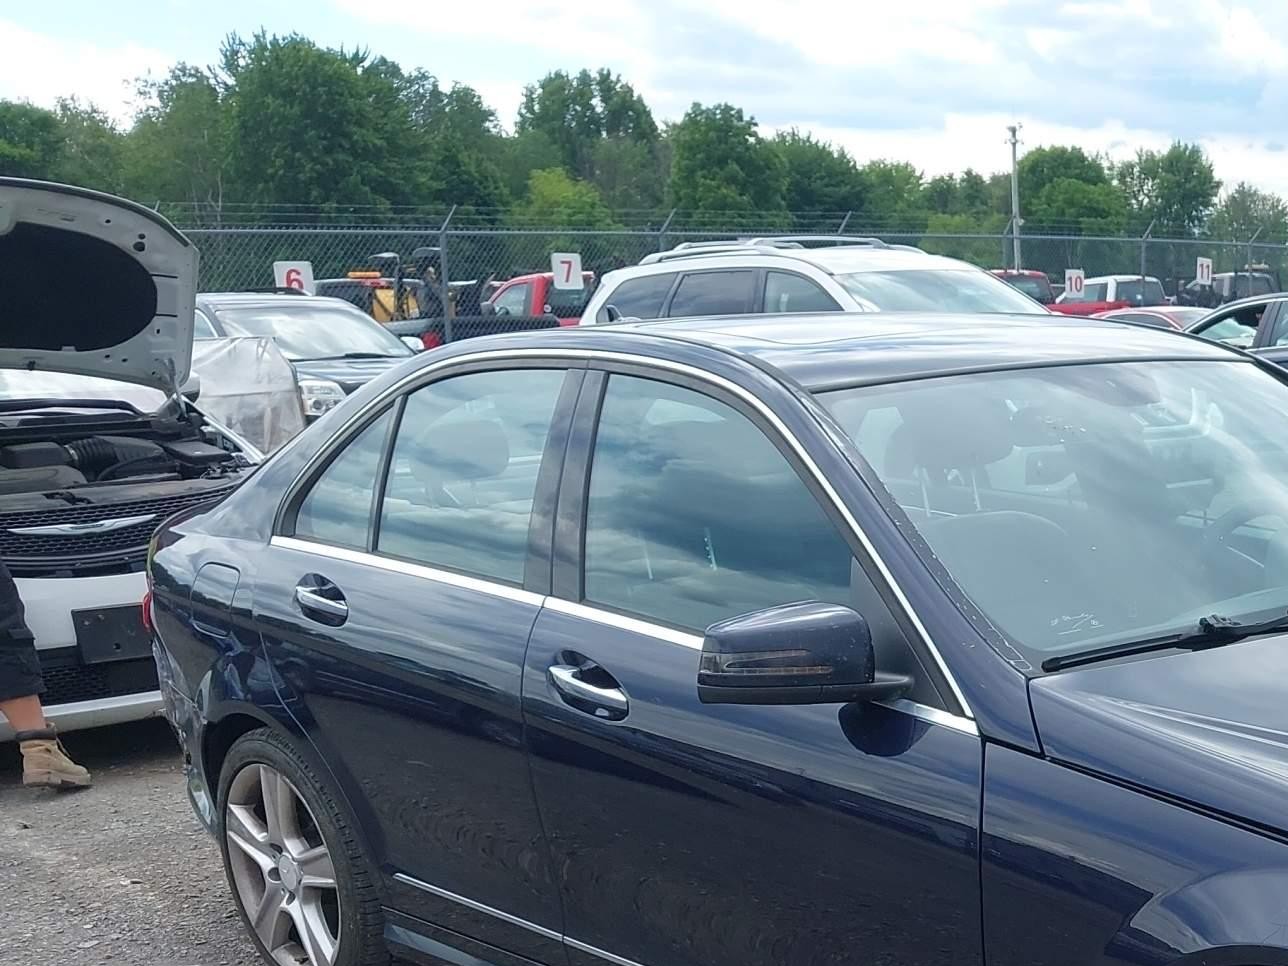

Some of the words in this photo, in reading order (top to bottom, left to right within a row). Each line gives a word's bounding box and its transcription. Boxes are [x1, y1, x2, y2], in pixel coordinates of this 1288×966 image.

[286, 269, 304, 290] 6
[560, 261, 572, 283] 7
[1199, 263, 1210, 281] 11
[1067, 276, 1083, 293] 10
